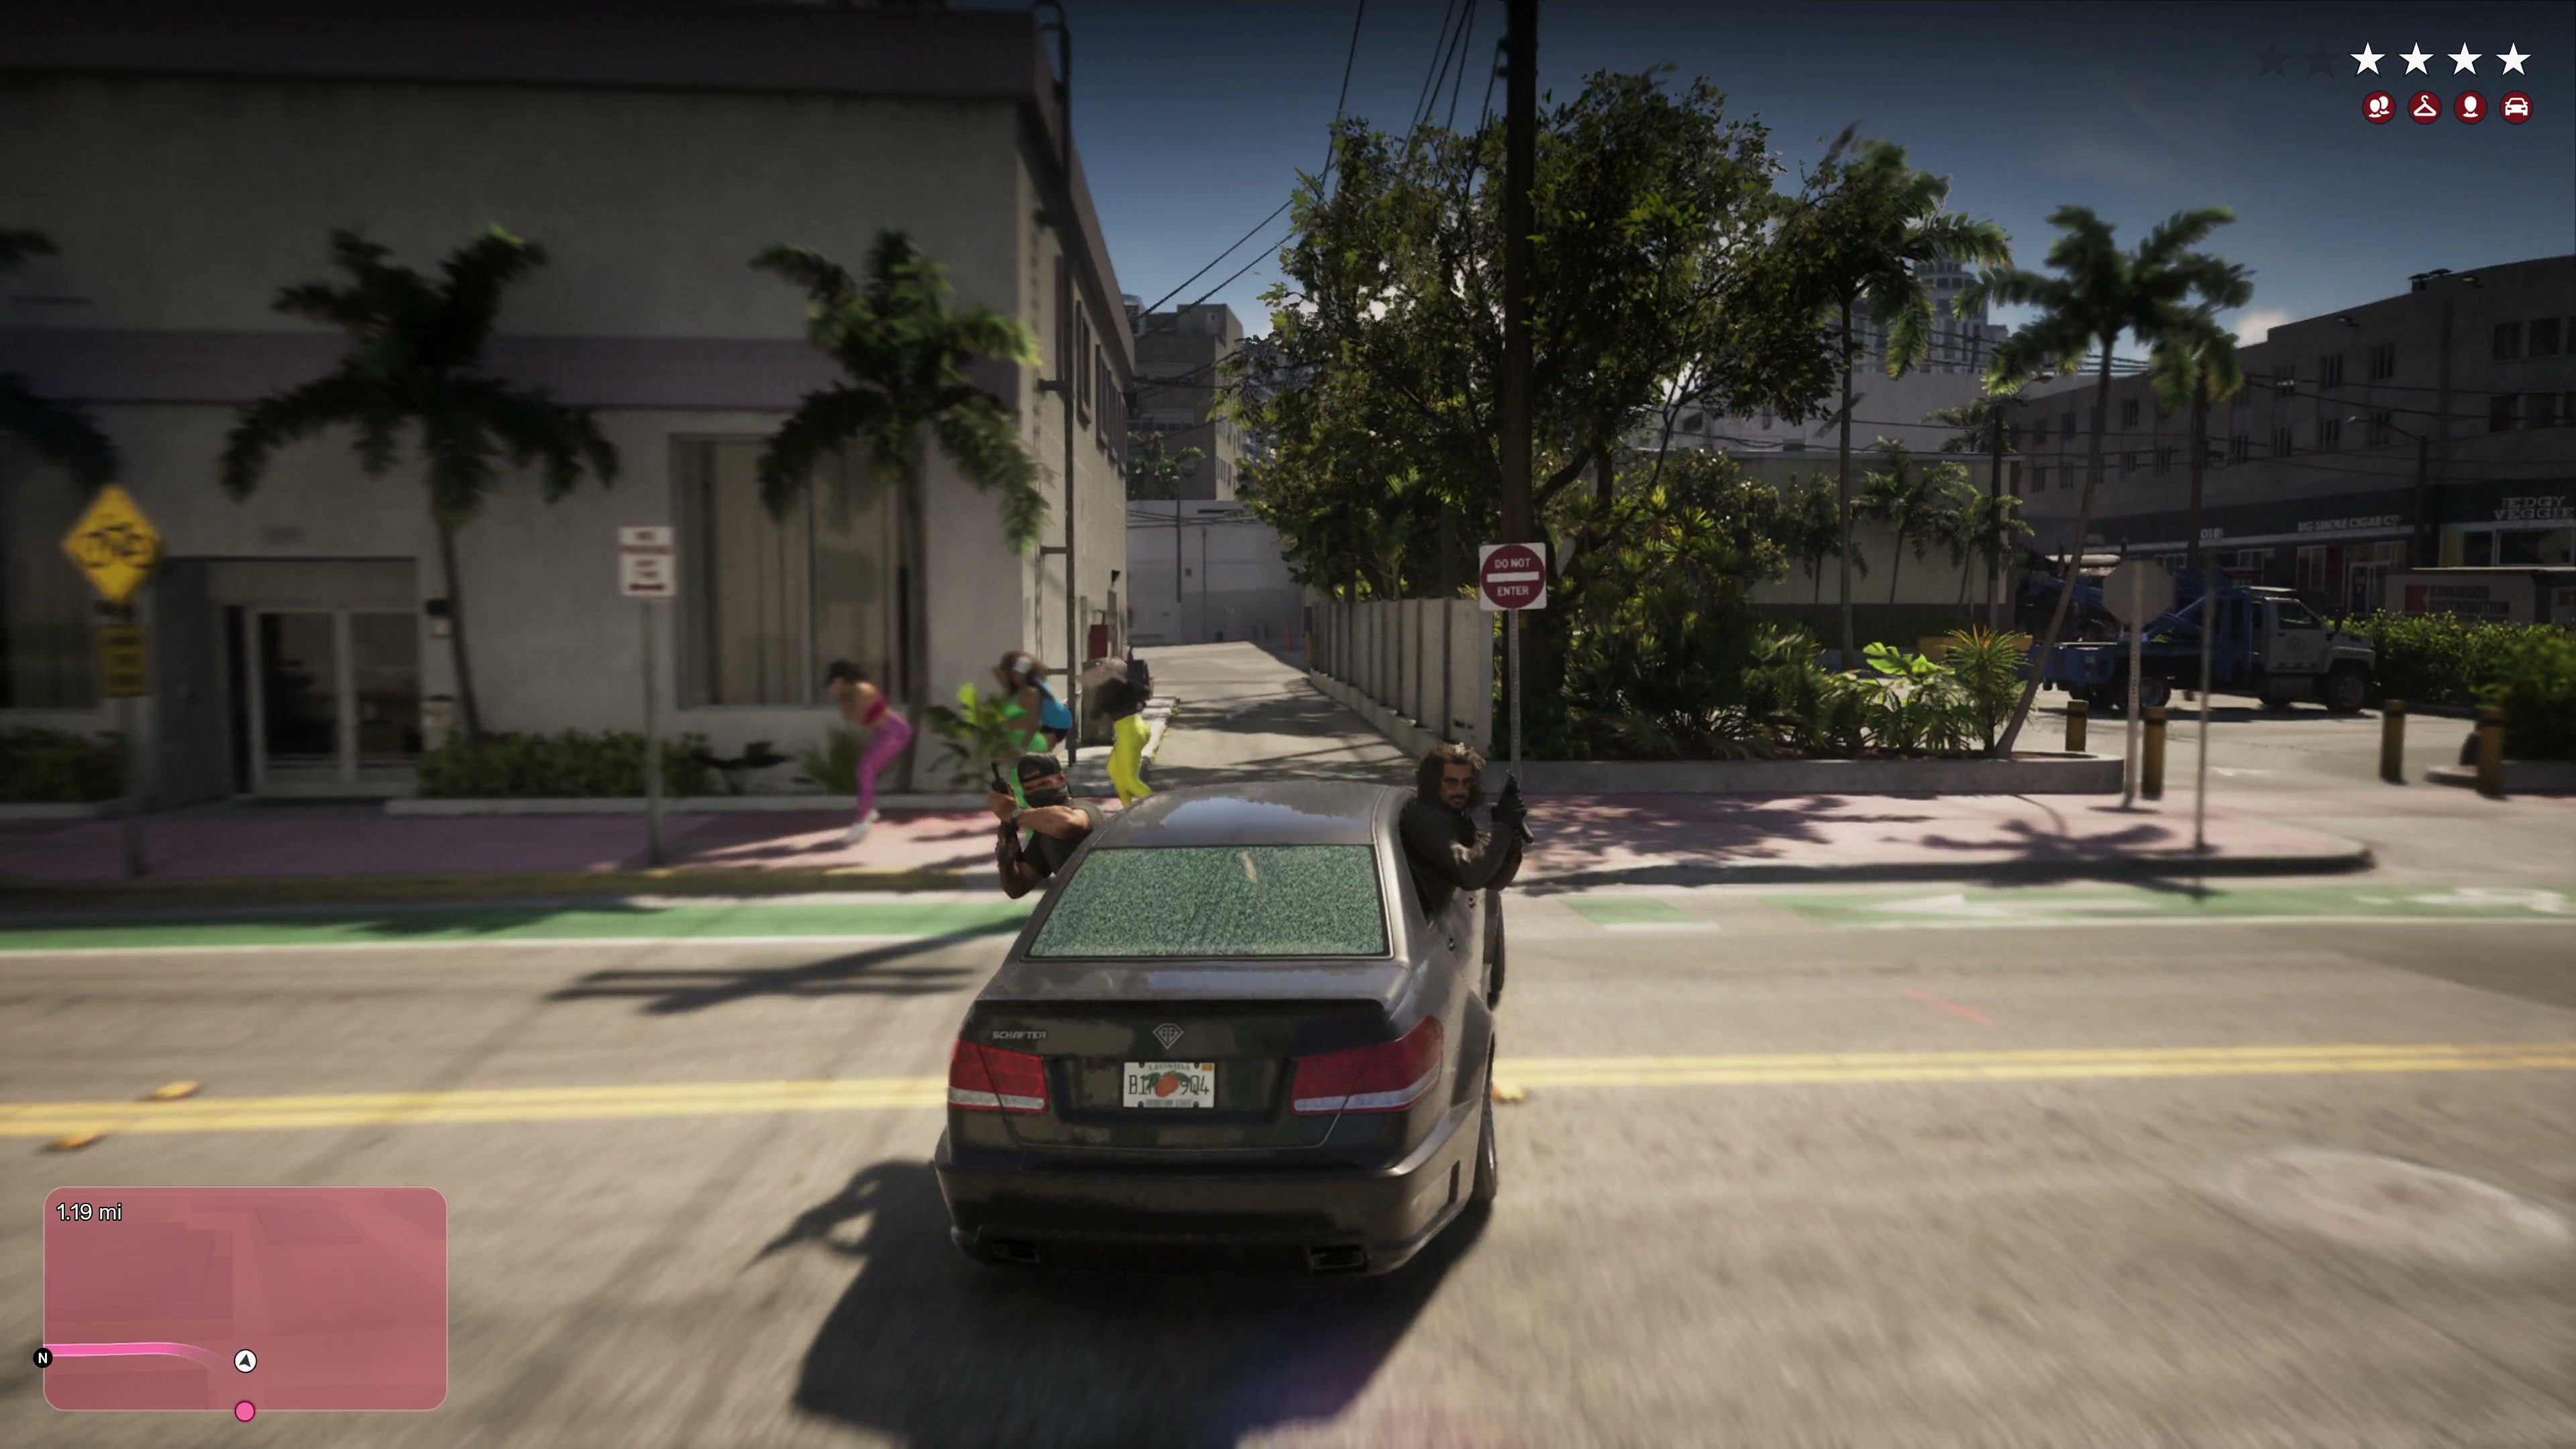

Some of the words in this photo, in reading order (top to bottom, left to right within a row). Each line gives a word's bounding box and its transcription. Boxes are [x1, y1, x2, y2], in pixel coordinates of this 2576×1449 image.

[2502, 496, 2565, 508] EDGY
[2493, 507, 2575, 520] VEGGIE
[1494, 559, 1508, 568] DO
[1511, 557, 1531, 568] NOT
[1497, 586, 1529, 596] ENTER
[991, 1030, 1046, 1039] SCHAFTER
